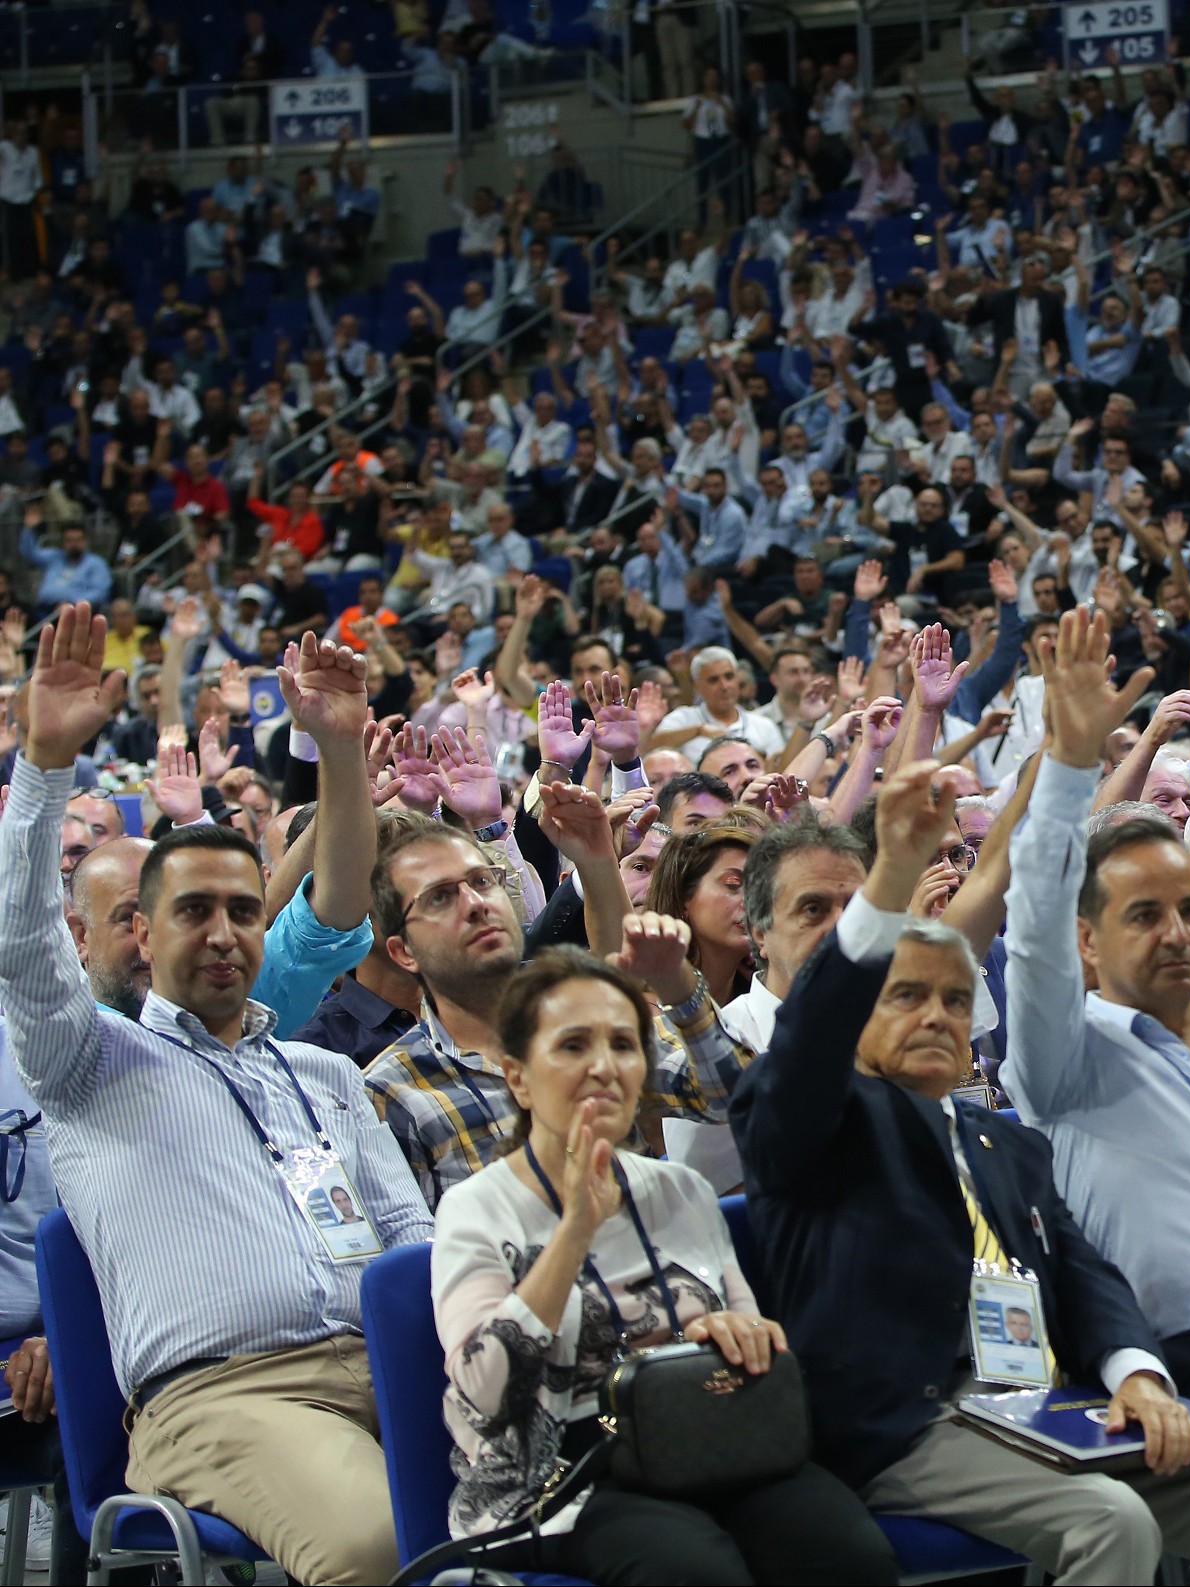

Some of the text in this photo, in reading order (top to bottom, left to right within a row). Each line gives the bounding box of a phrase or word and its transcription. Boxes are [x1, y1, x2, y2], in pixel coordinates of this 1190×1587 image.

[1108, 5, 1154, 28] 205
[310, 87, 352, 107] 206
[503, 104, 546, 129] 206
